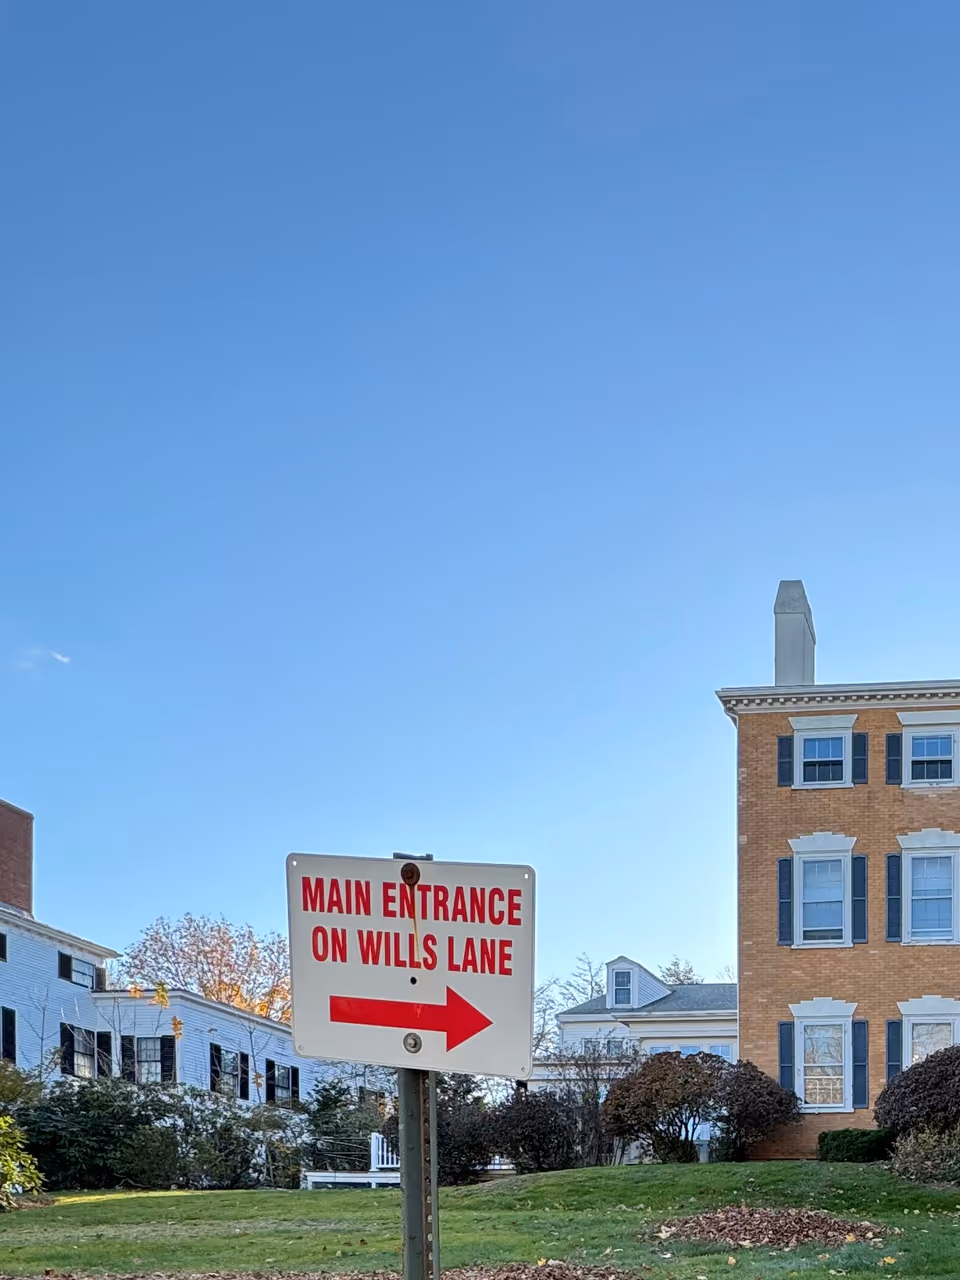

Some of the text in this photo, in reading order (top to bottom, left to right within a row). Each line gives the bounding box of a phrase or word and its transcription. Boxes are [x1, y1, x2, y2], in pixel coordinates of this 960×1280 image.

[301, 876, 522, 926] MAIN ENTRANCE
[311, 925, 513, 976] ON WILLS LANE
